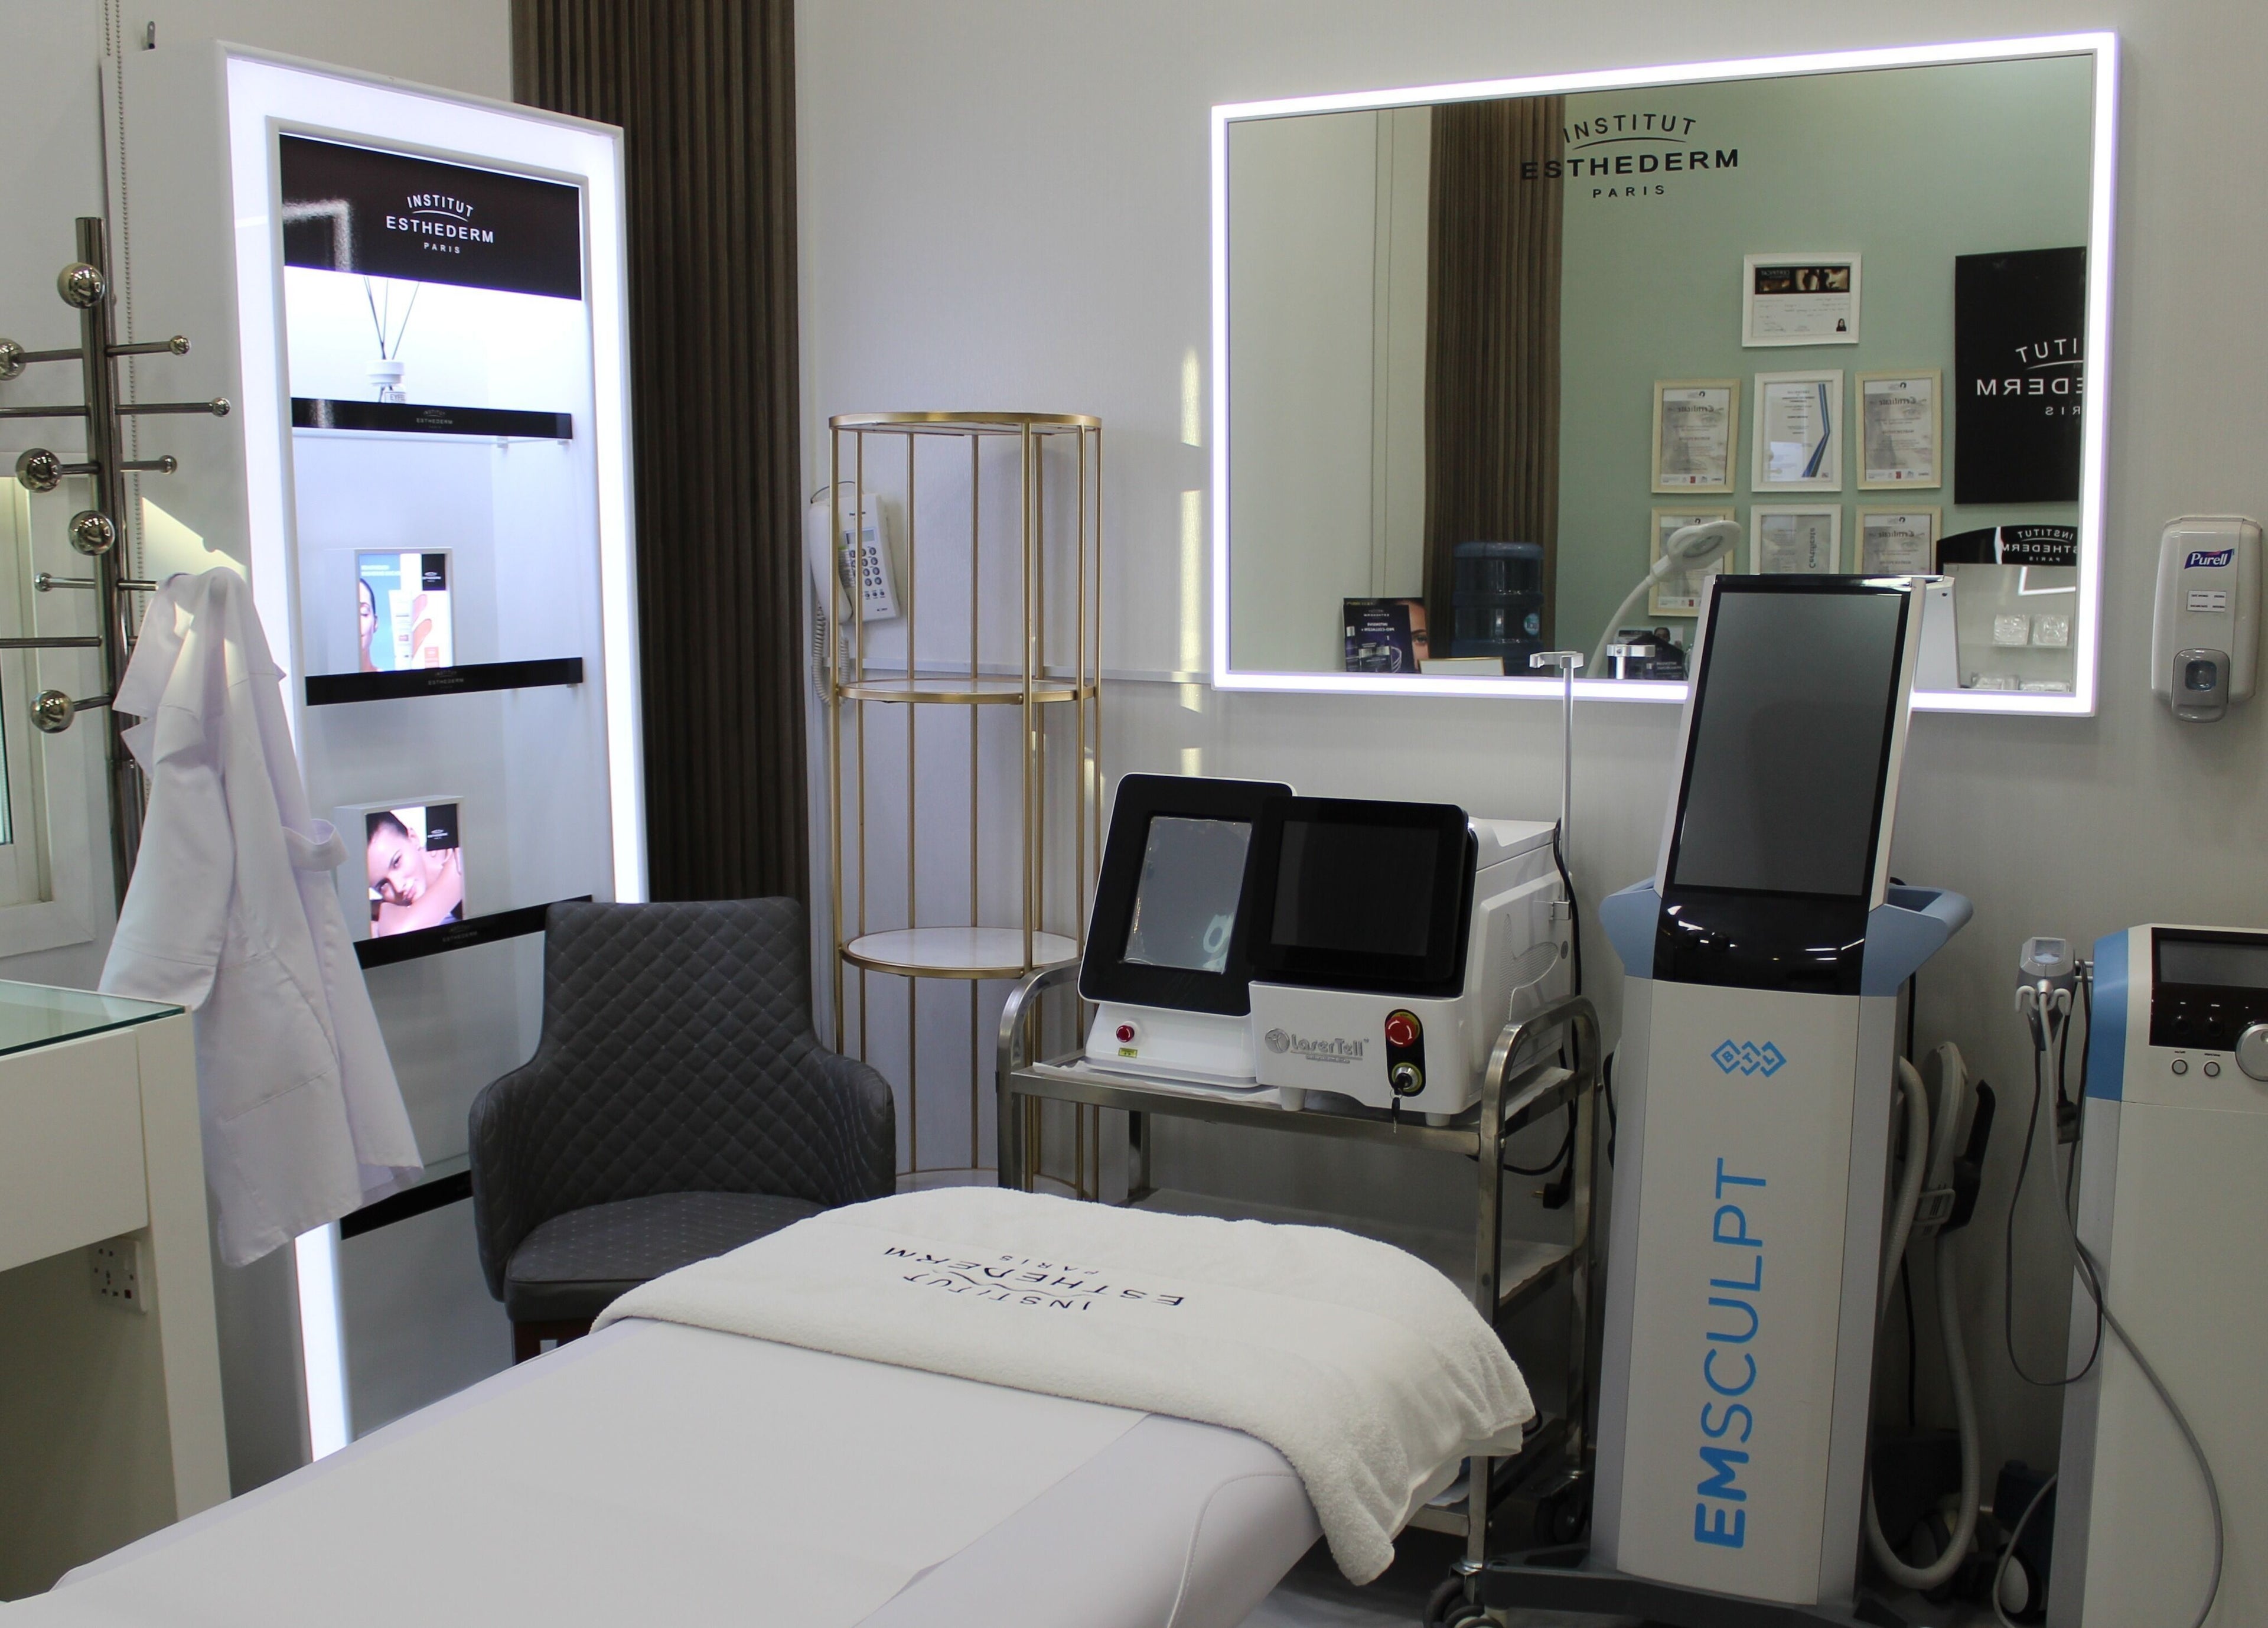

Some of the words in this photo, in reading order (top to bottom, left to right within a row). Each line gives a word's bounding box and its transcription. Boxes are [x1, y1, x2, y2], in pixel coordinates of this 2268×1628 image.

[1563, 113, 1697, 144] INSTITUT
[1521, 149, 1738, 181] ESTHEDERM
[406, 194, 474, 217] INSTITUT
[1592, 185, 1665, 198] PARIS
[386, 215, 494, 243] ESTHEDERM
[423, 242, 461, 254] PARIS
[2190, 552, 2228, 565] Purell
[884, 1247, 1185, 1306] ESTHEDERM
[1000, 1255, 1099, 1274] PARIS
[902, 1273, 1091, 1310] INSTITUT
[1694, 1157, 1767, 1549] EMSCULPT
